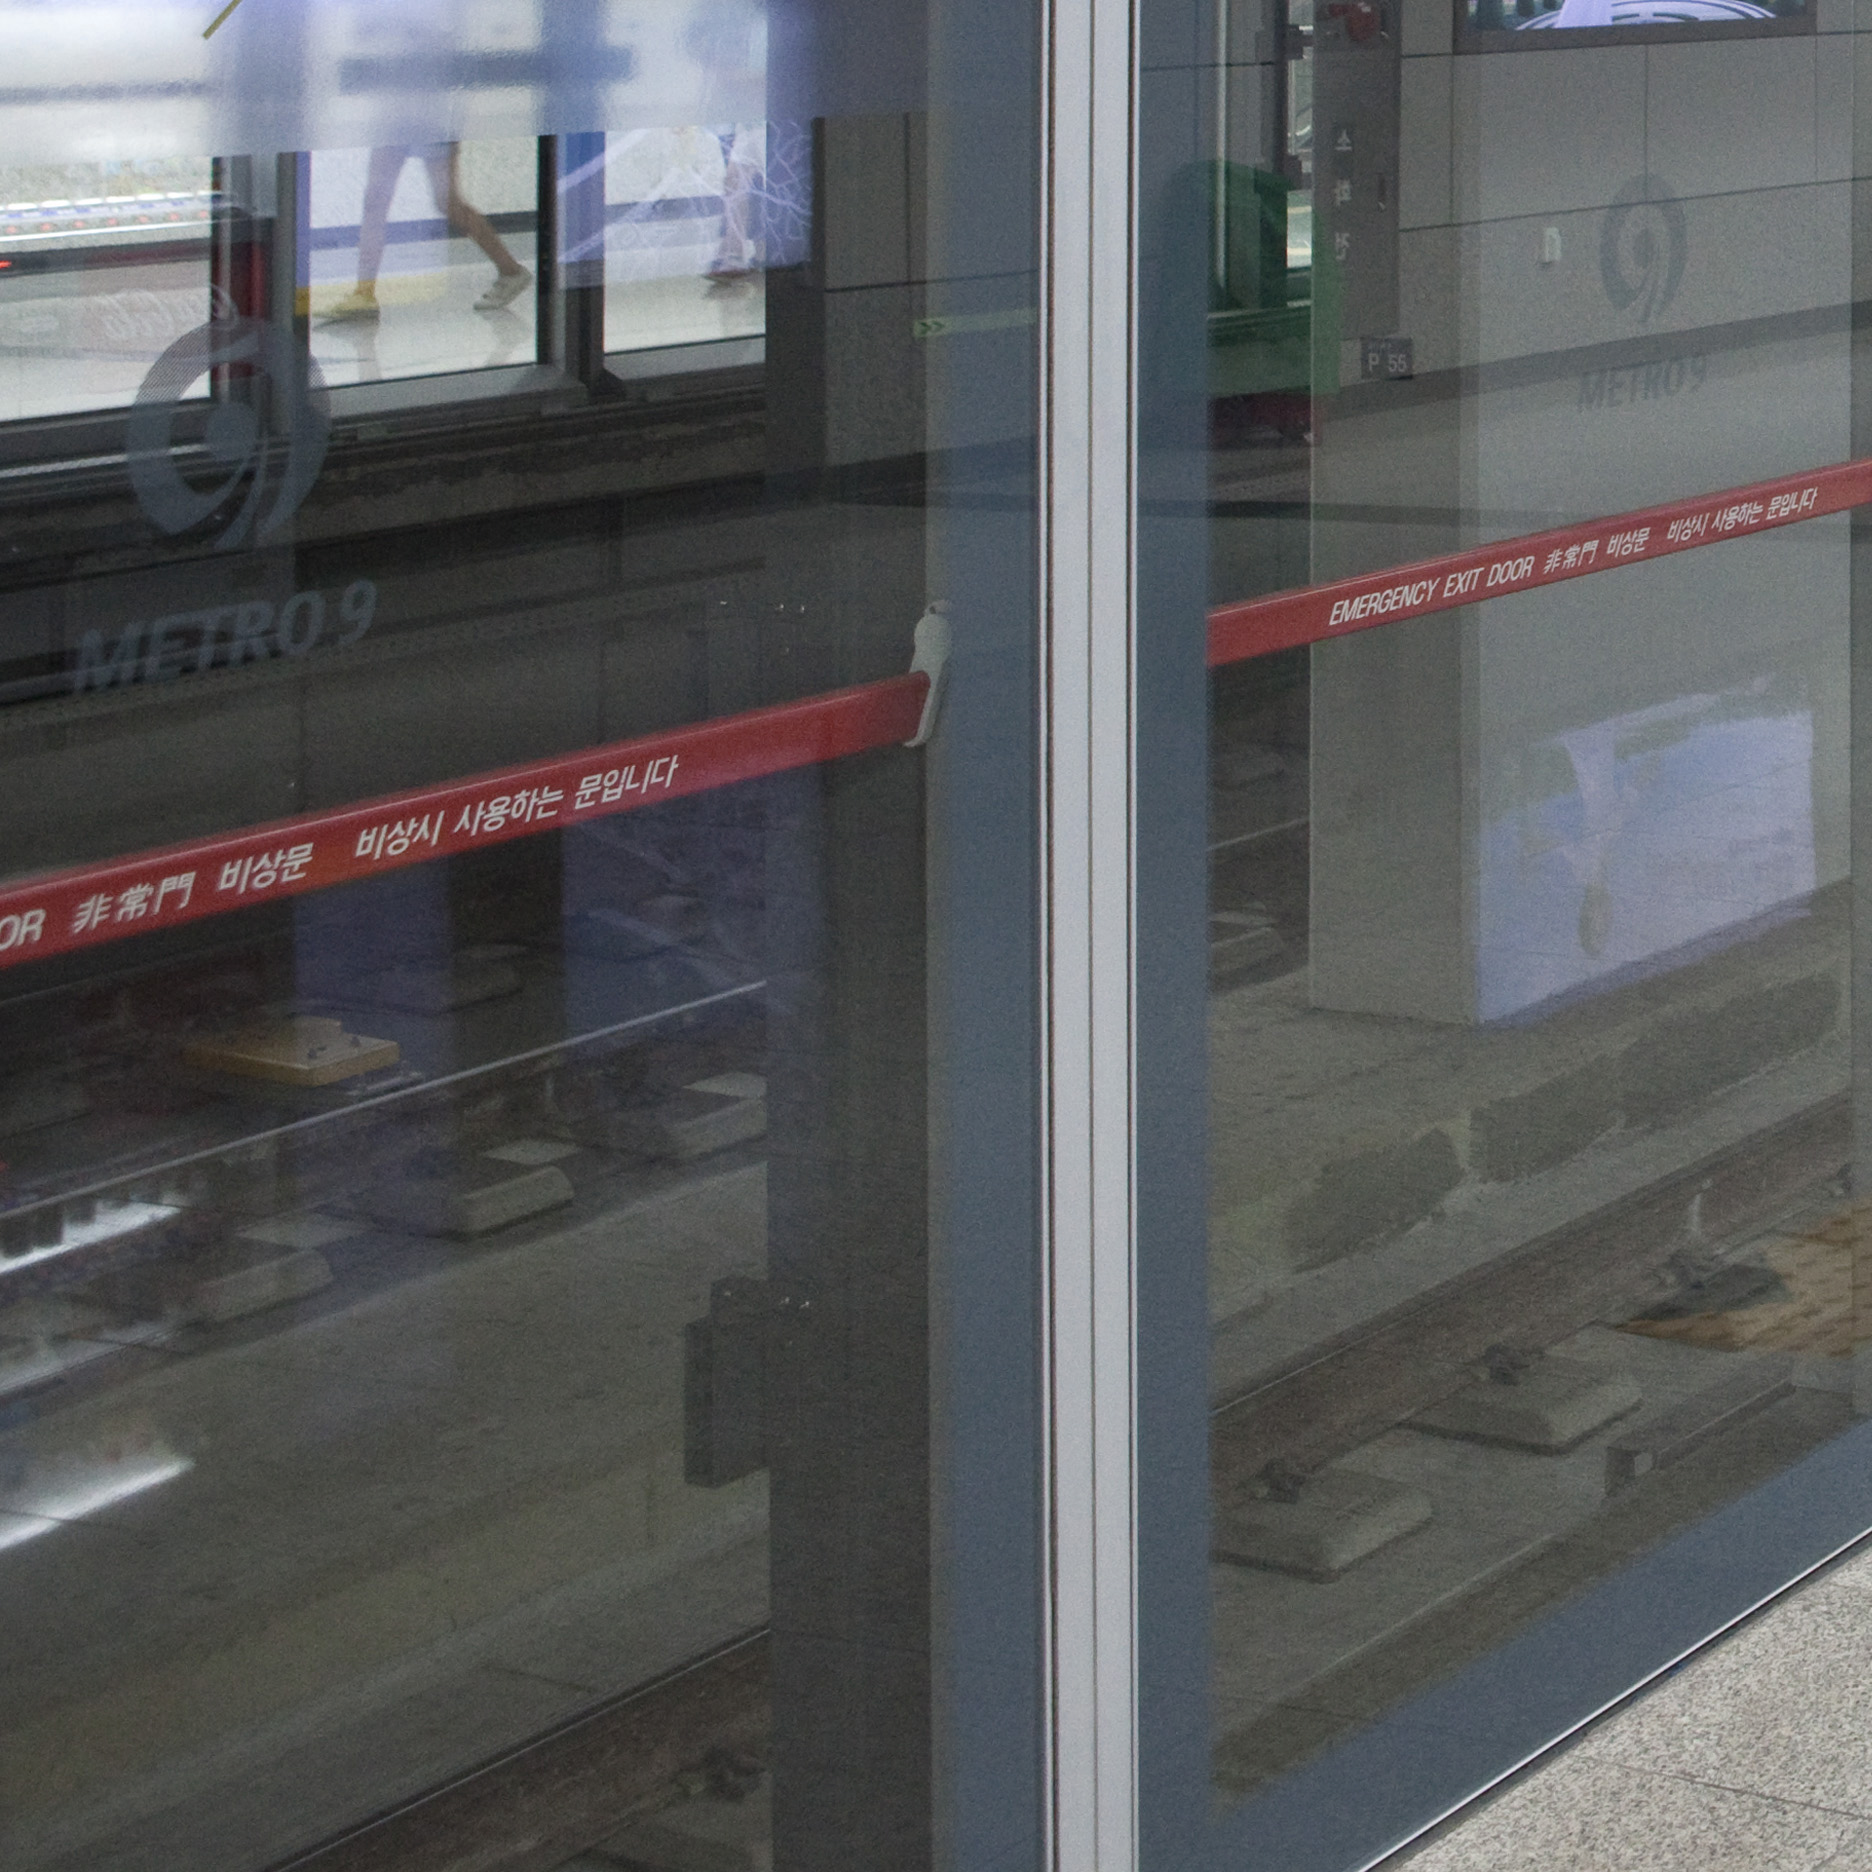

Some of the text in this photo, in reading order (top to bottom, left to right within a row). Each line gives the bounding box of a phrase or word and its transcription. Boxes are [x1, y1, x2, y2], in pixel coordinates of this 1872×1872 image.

[1328, 486, 1820, 627] EMERGENCY EXIT DOOR 非常門 비상문 비상시 사용하는 문입니다
[70, 869, 197, 935] 非常門
[218, 842, 316, 899] 비상문
[354, 809, 447, 866] 비상시
[452, 781, 566, 840] 사용하는
[571, 752, 683, 813] 문입니다
